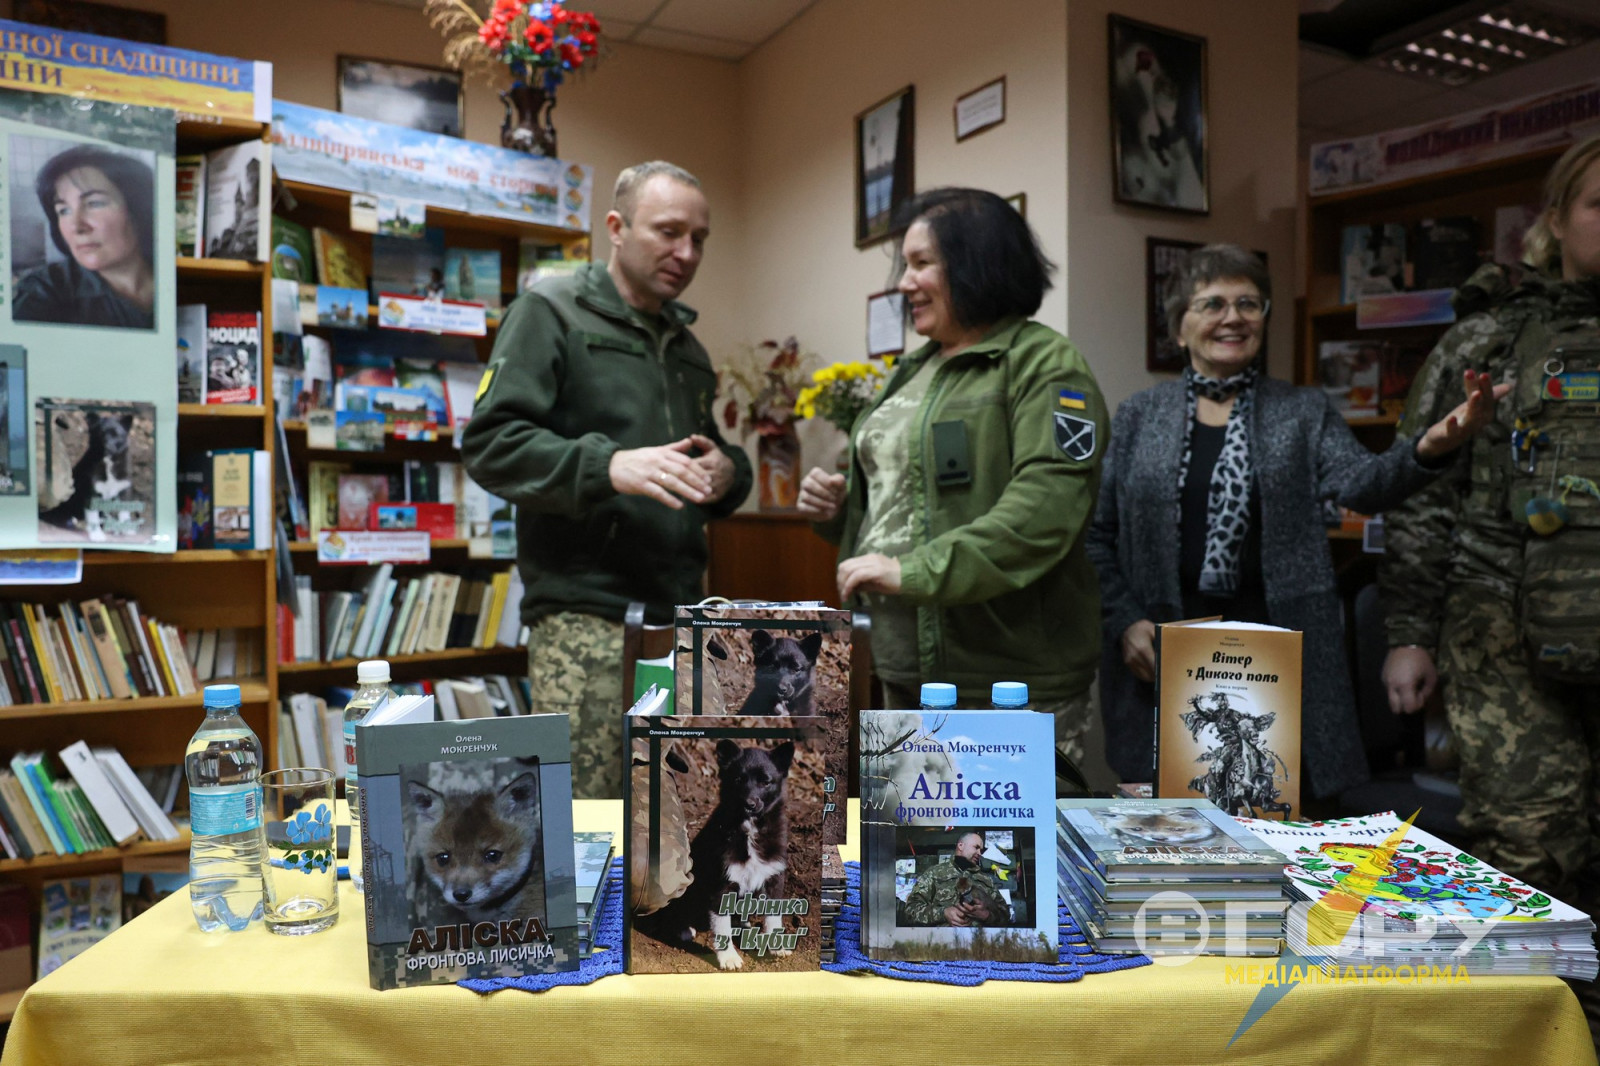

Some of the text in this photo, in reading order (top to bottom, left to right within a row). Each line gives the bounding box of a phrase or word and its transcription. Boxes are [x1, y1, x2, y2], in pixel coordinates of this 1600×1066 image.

[69, 41, 241, 85] СПАДЩИНИ
[1211, 650, 1253, 668] Вітер
[1186, 666, 1279, 683] з Дикого поля
[455, 735, 482, 743] Олена
[670, 729, 705, 737] Мокренчук
[441, 743, 498, 755] МОКРЕНЧУК
[902, 741, 1027, 757] Олена Мокренчук
[908, 773, 1022, 801] Аліска
[895, 803, 1035, 823] фронтова лисичка
[1243, 825, 1328, 837] країна
[1349, 826, 1400, 838] мрія
[719, 892, 809, 921] Афінка
[406, 916, 556, 955] АЛІСКА,
[715, 926, 808, 957] з "Куби"
[407, 944, 556, 971] ФРОНТОВА ЛИСИЧКА
